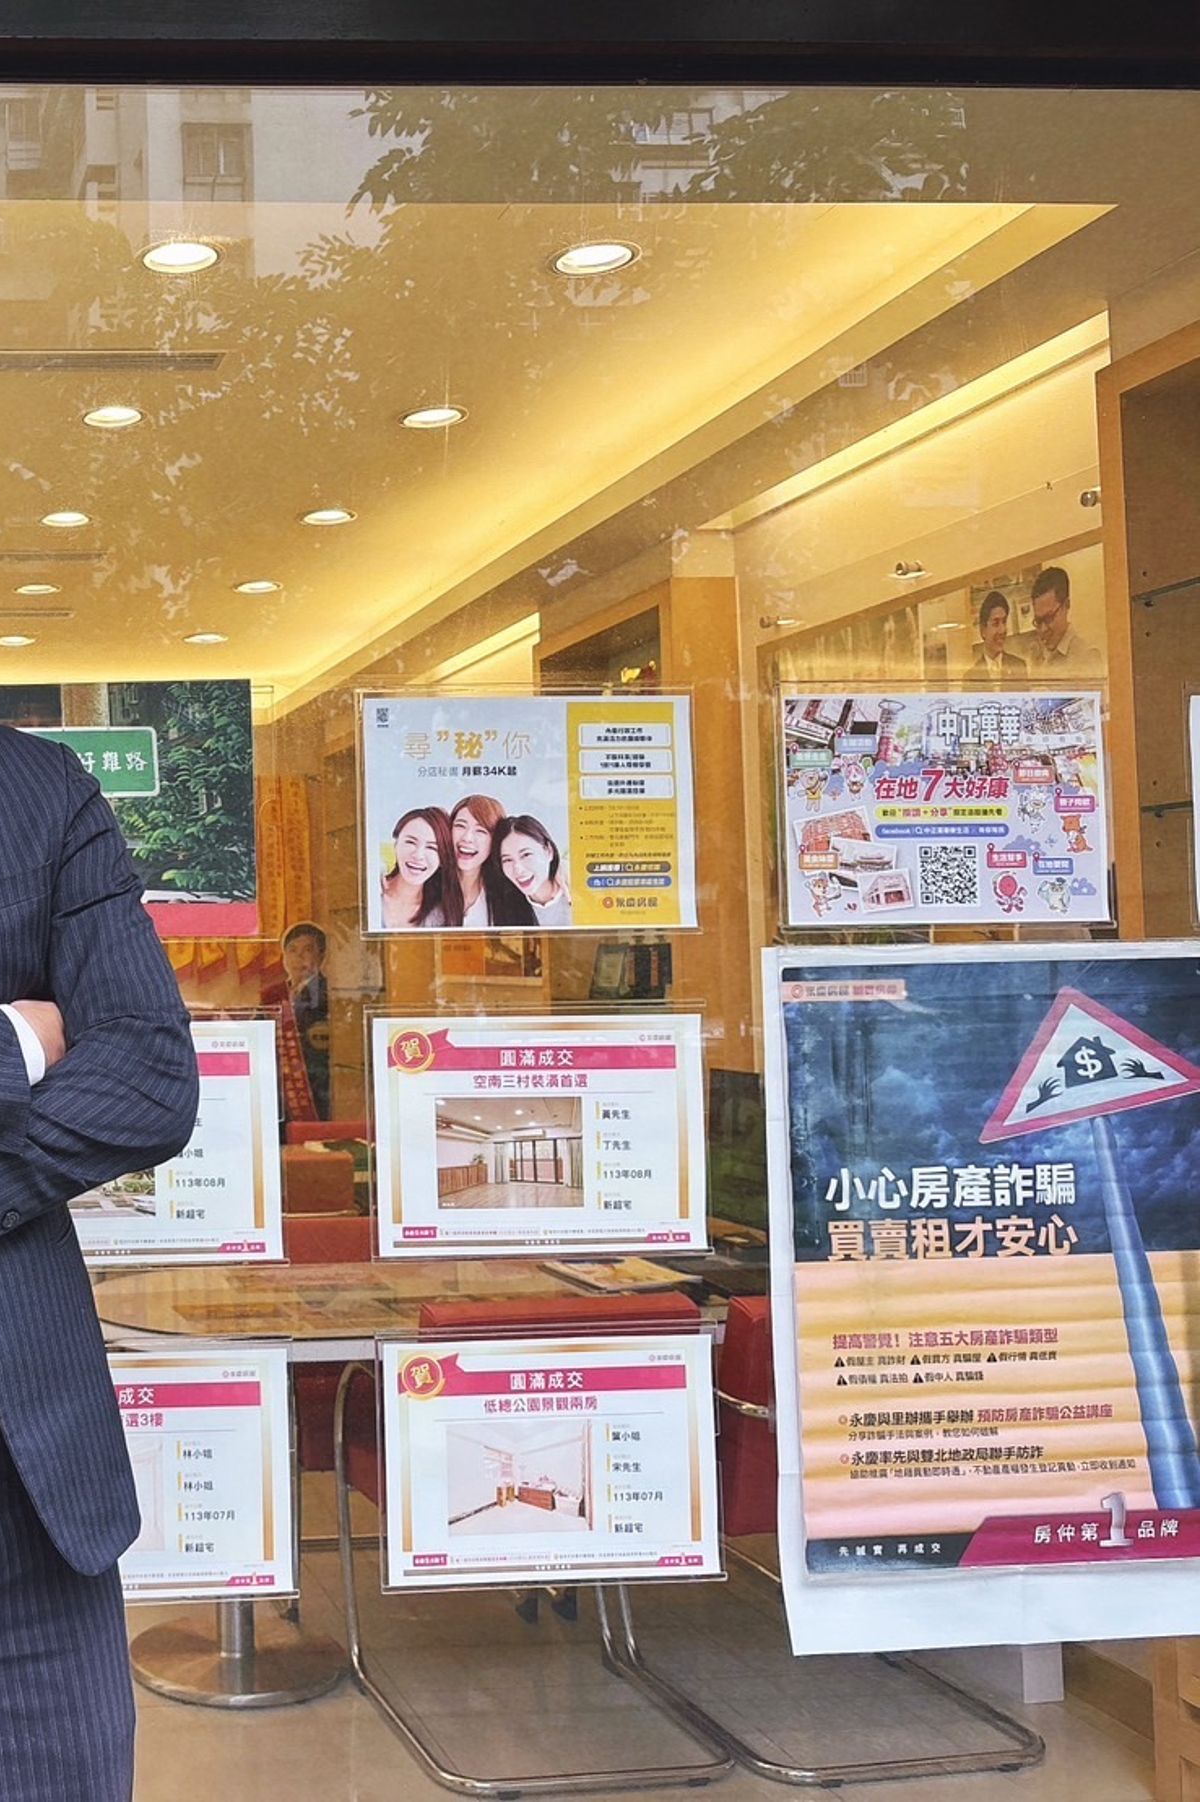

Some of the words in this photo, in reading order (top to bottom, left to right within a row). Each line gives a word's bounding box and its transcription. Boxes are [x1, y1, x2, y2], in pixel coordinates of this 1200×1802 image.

[937, 703, 1021, 745] 中正萬華
[875, 769, 1010, 801] 在地7大好康
[400, 1038, 424, 1063] 賀
[500, 1049, 574, 1066] 圓滿成交
[473, 1073, 589, 1089] 空南三村裝潢首選
[825, 1162, 1076, 1211] 小心房產詐騙
[826, 1215, 1079, 1263] 買賣租才安心
[909, 1328, 1059, 1348] 注意五大房產詐騙類型
[410, 1363, 434, 1389] 賀
[510, 1371, 583, 1391] 圓滿成交
[118, 1387, 154, 1405] 成交
[120, 1413, 163, 1428] 選3樓
[977, 1403, 1114, 1423] 預防房產詐騙公益講座
[851, 1445, 1044, 1467] 永慶率先與雙北地政局聯手防詐
[1034, 1492, 1180, 1549] 房仲第1品牌
